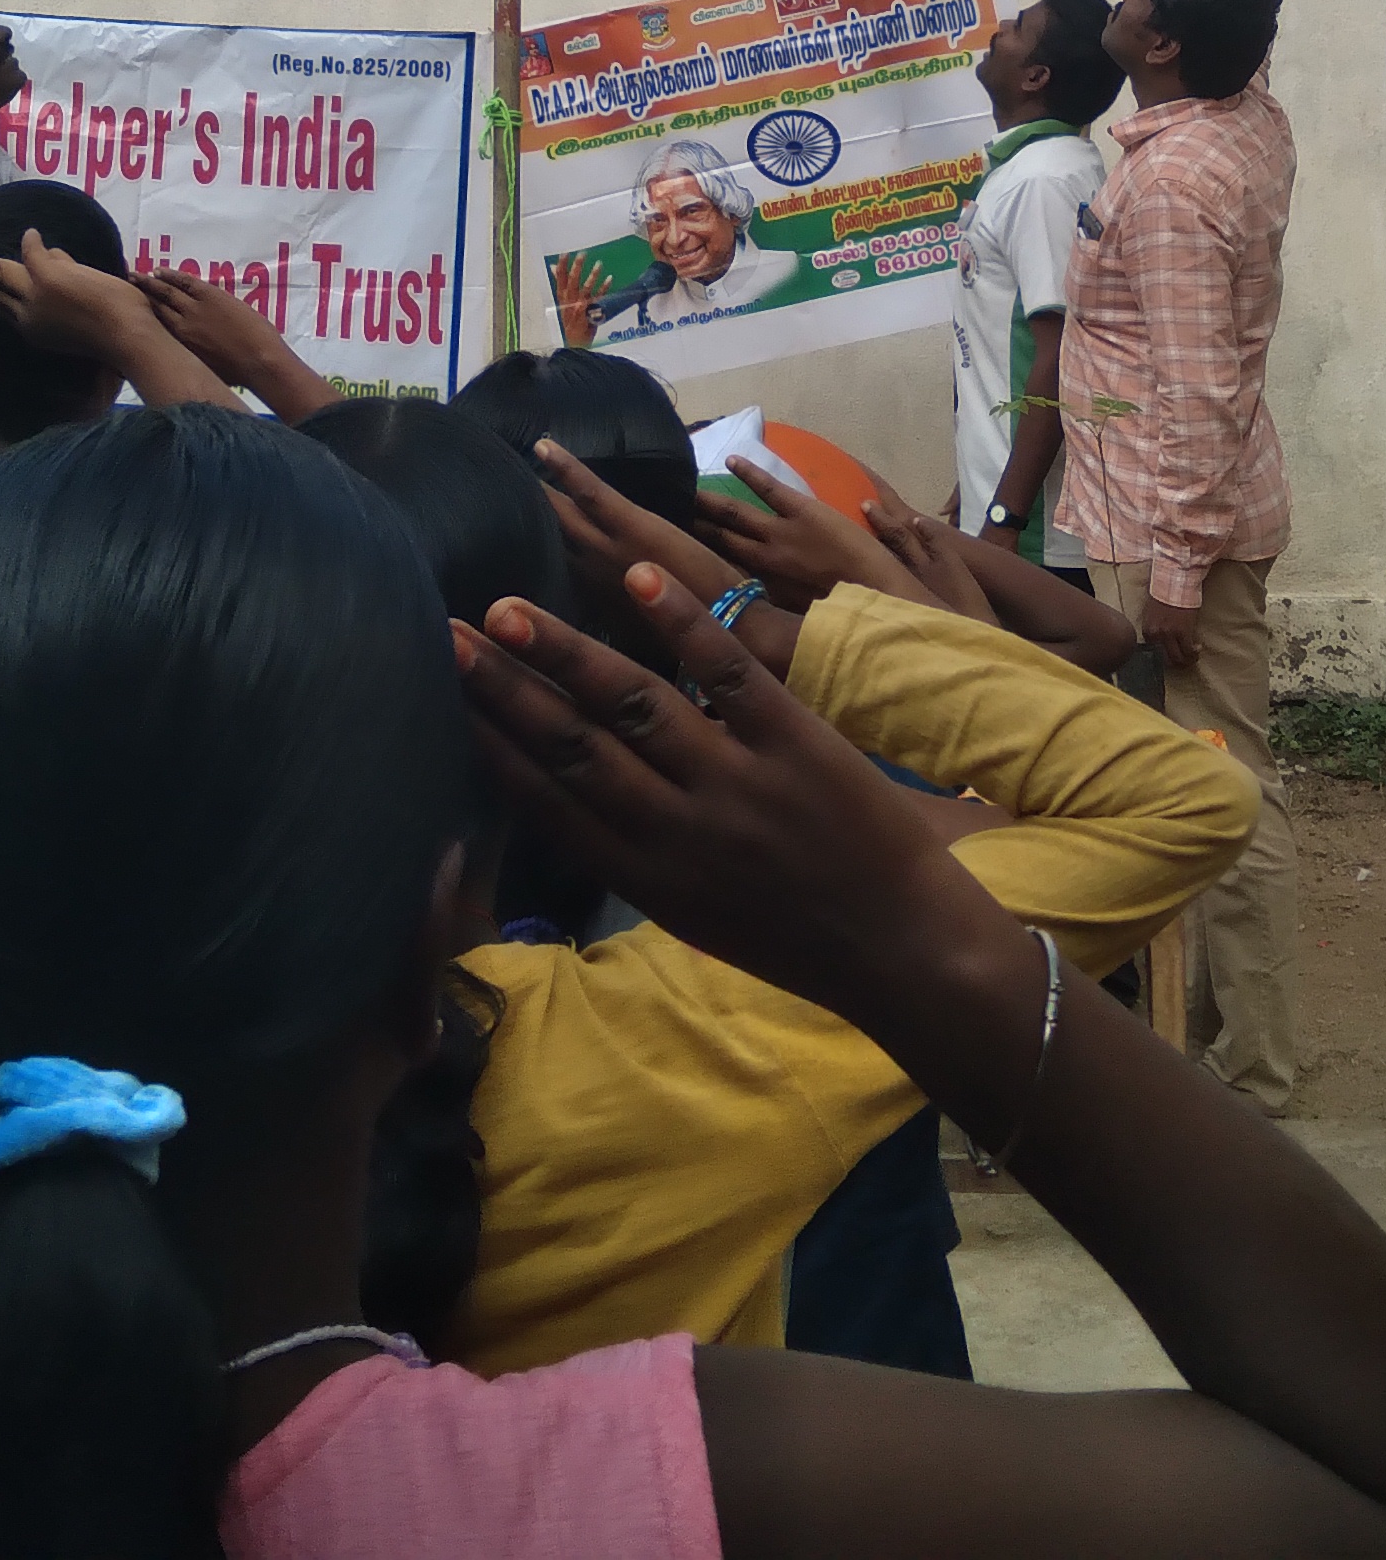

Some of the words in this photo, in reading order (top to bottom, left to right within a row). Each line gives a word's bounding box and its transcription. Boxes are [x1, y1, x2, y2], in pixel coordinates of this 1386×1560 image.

[272, 53, 452, 82] (Reg.No.825/2008)
[596, 46, 717, 118] அப்துல்கலாம்
[721, 19, 834, 82] மாணவர்கள்
[836, 3, 910, 70] நற்பணி
[780, 85, 835, 107] நேரு
[241, 91, 377, 191] India
[834, 203, 902, 238] திண்டுக்கல்
[903, 188, 956, 217] மாவட்டம்
[814, 242, 867, 267] செல்:
[870, 226, 940, 254] 89400
[312, 243, 447, 345] Trust
